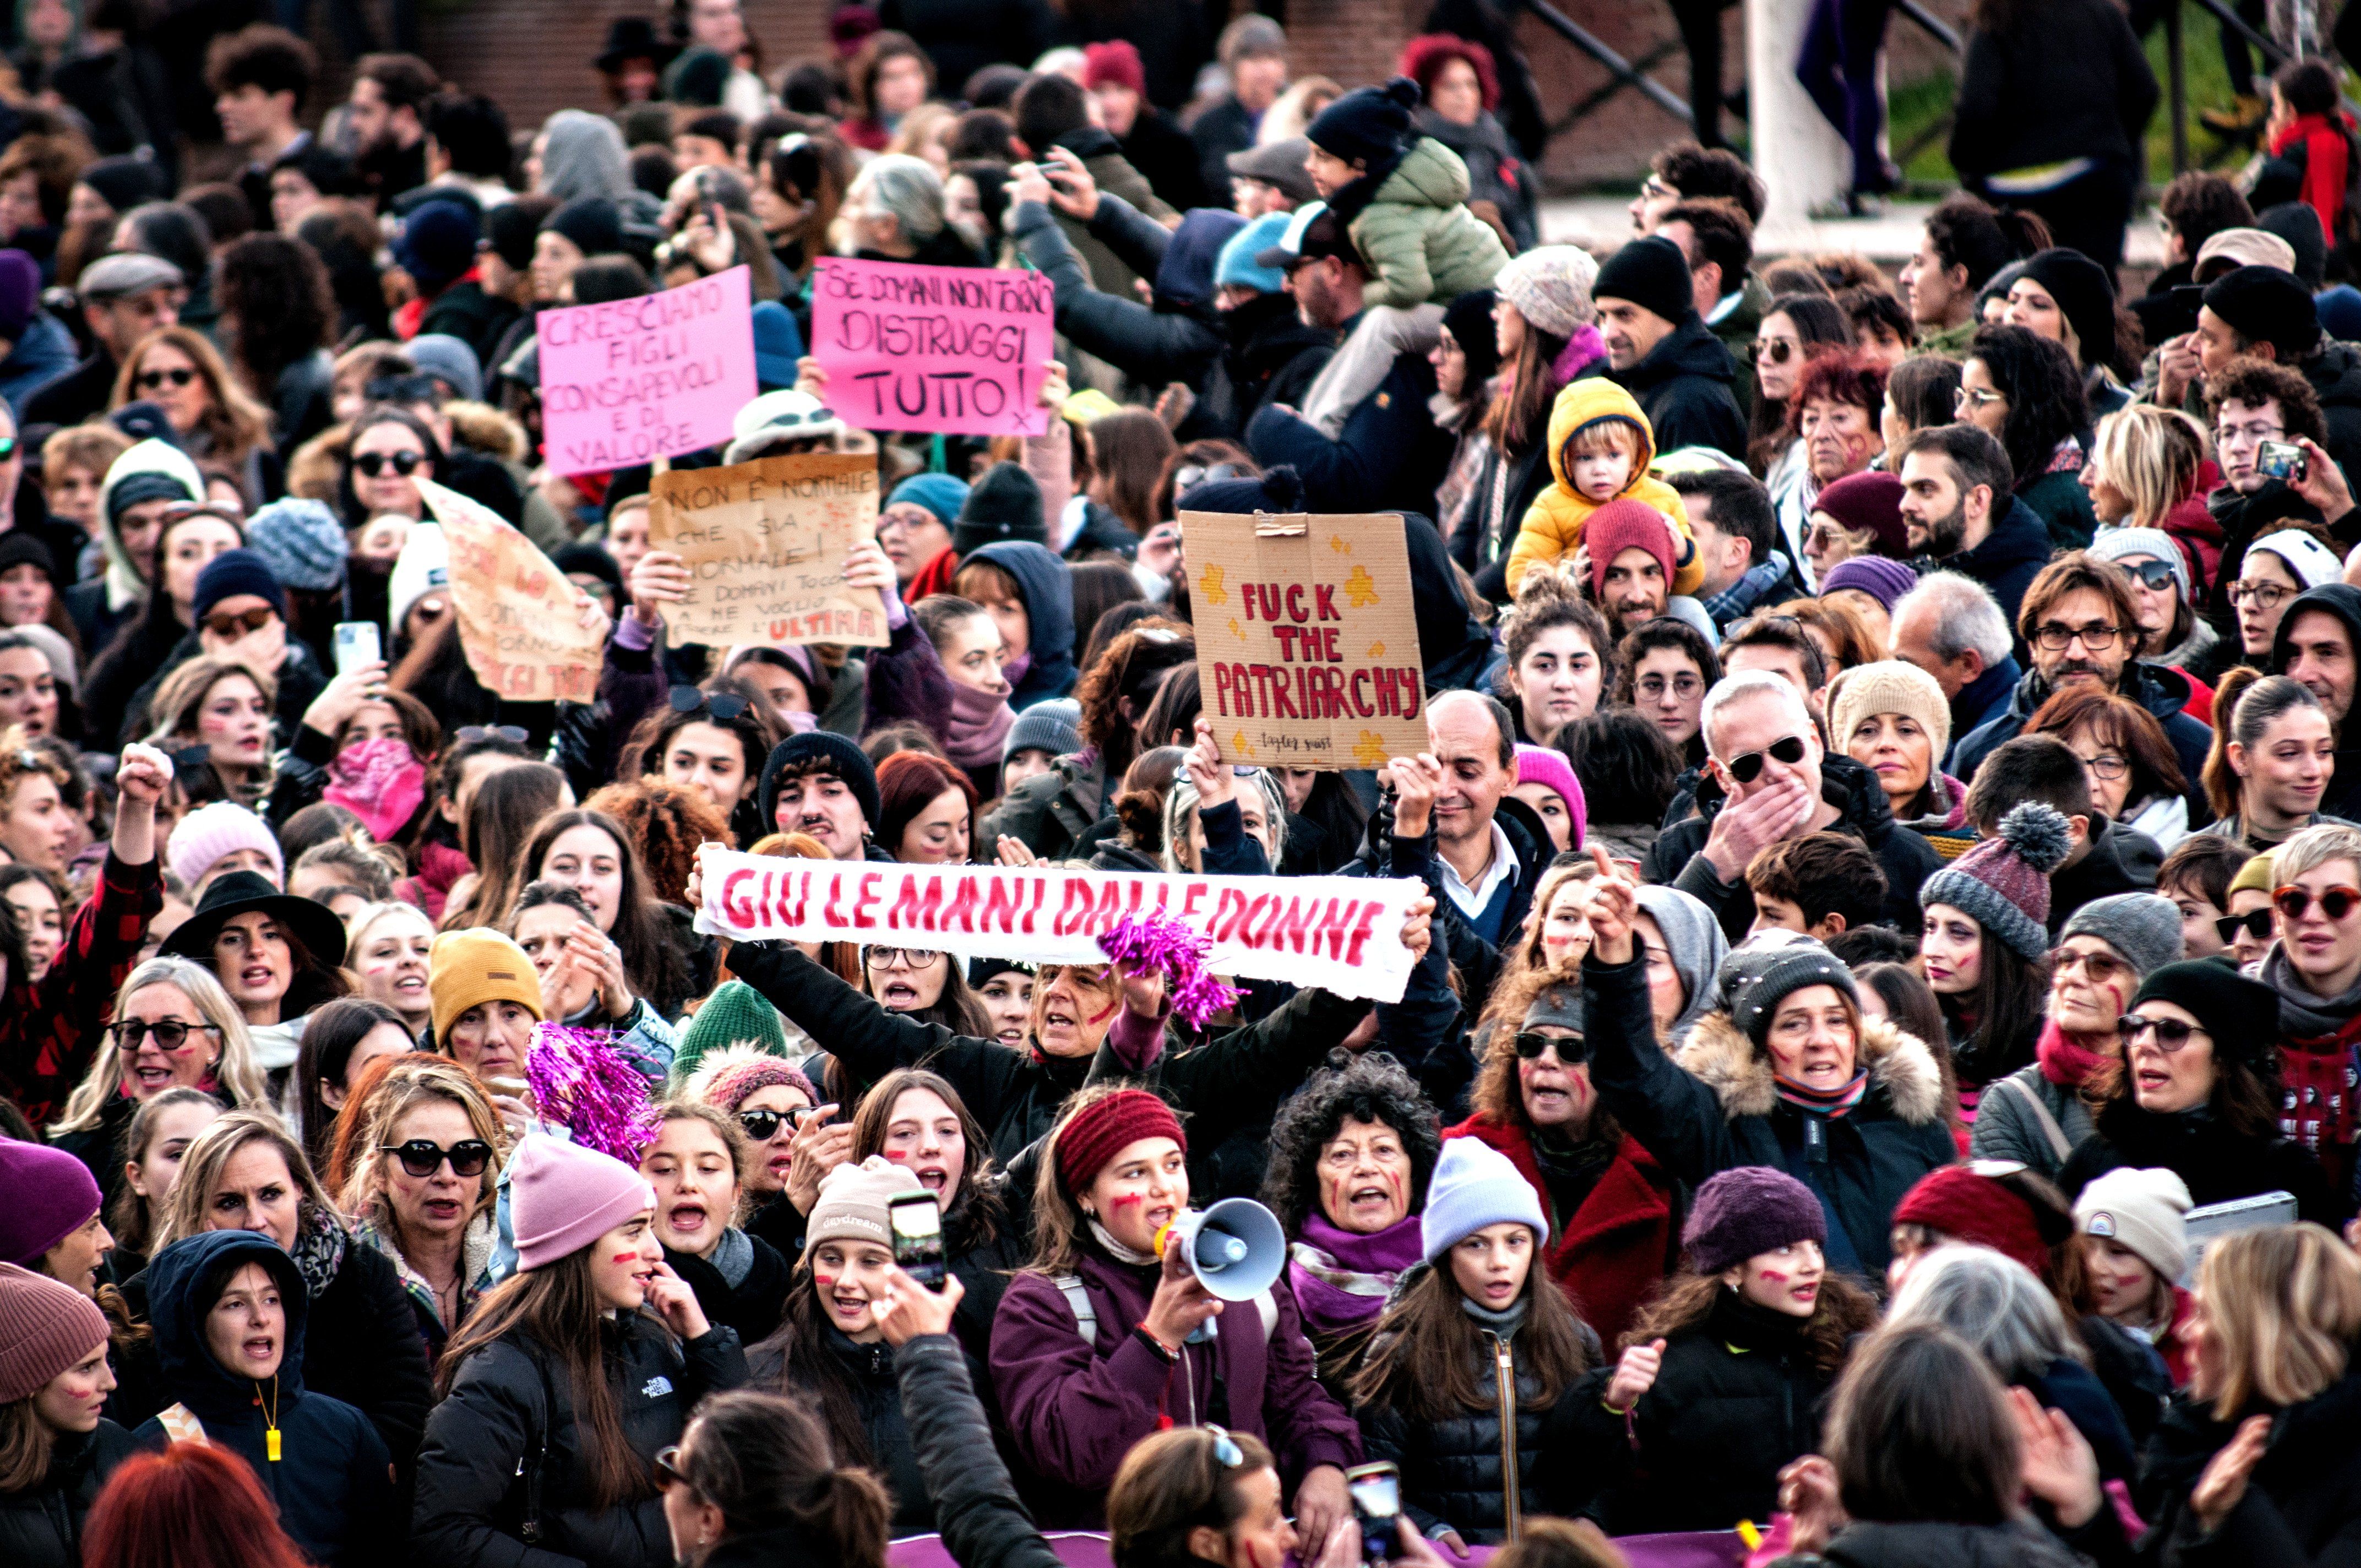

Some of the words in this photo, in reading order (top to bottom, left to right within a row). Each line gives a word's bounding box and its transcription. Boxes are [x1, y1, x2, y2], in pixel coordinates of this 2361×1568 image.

[828, 265, 862, 299] SE
[871, 274, 942, 306] DOMANI
[948, 279, 991, 308] NON
[995, 279, 1054, 315] TORNO
[544, 282, 722, 346] CRESCIAMO
[607, 333, 688, 369] FIGLI
[836, 309, 1026, 364] DISTRUGGI
[544, 355, 724, 413] CONSAPEVOLI
[612, 411, 627, 432] E
[640, 406, 666, 427] DI
[566, 421, 698, 466] VALORE
[669, 486, 730, 511] NON
[782, 472, 873, 499] NORMALE
[676, 525, 724, 545] CHE
[757, 513, 798, 535] SIA
[711, 606, 739, 620] ME
[757, 596, 827, 616] VOGLIO
[715, 580, 786, 602] DOMANI
[1241, 583, 1342, 623] FUCK
[1272, 625, 1343, 662] THE
[1214, 662, 1421, 720] PATRIARCHY
[722, 868, 812, 929] GIU
[824, 872, 883, 929] LE
[888, 873, 1046, 934] MANI
[1206, 886, 1386, 967] DONNE
[823, 1213, 883, 1234] daydream
[641, 1382, 661, 1395] NORTH
[647, 1378, 659, 1387] THE
[649, 1388, 665, 1399] FACE
